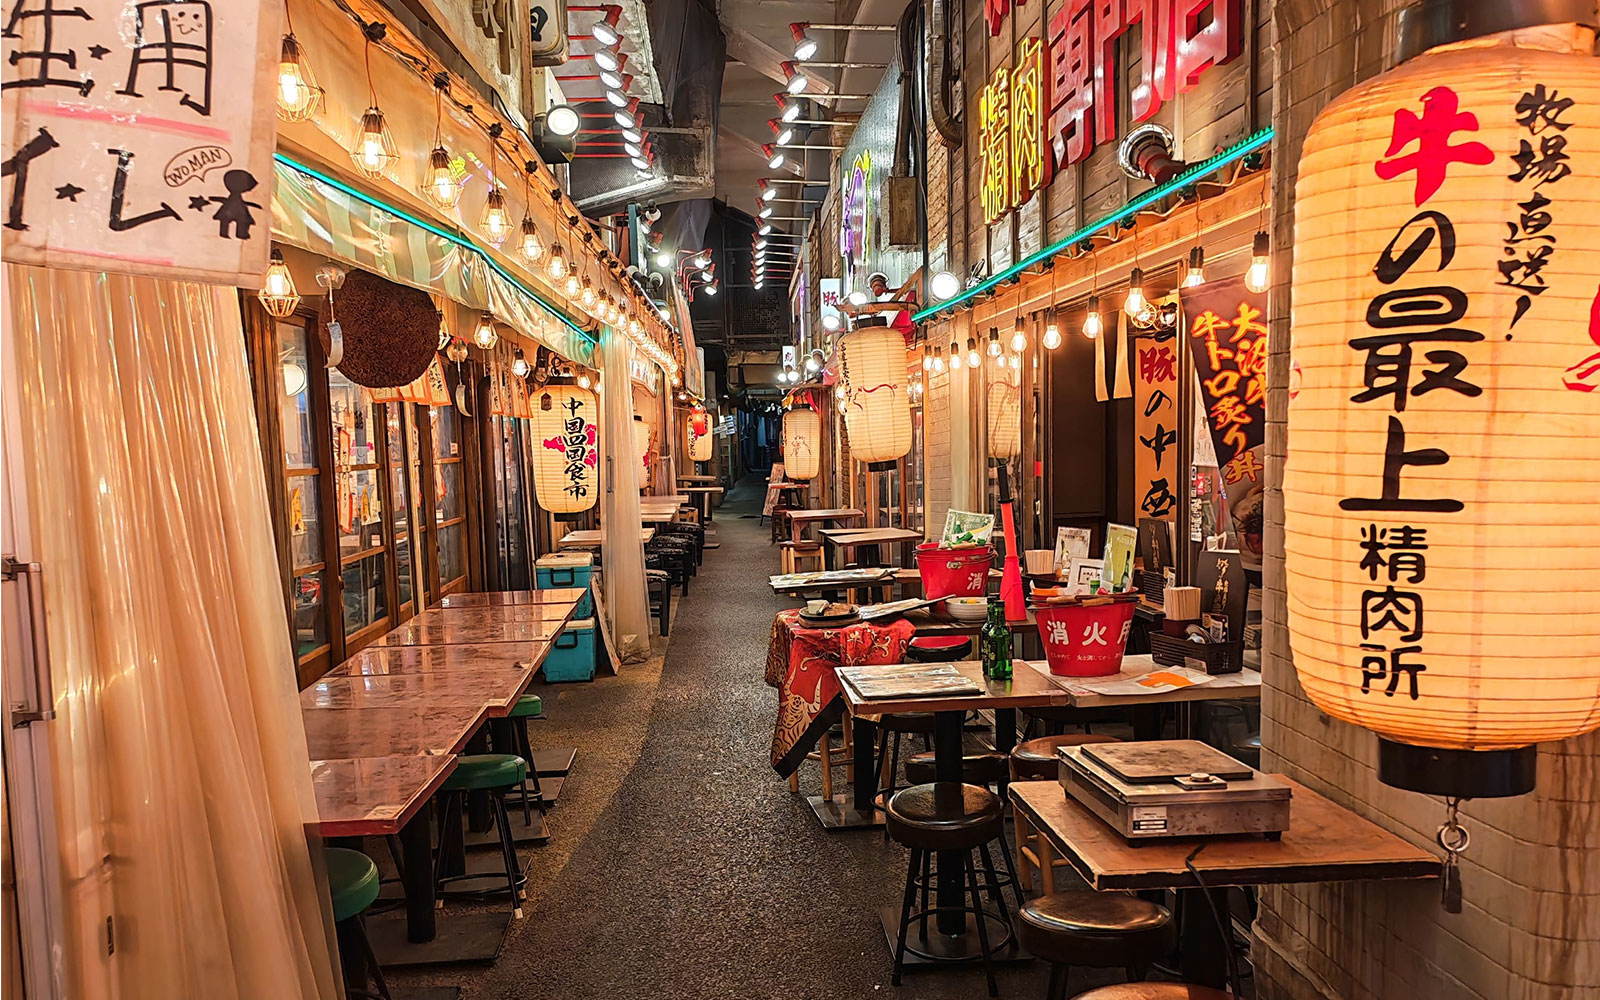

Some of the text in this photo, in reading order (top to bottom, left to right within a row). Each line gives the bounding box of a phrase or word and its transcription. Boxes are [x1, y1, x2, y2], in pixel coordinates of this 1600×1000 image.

[1493, 83, 1576, 341] 牧場直送!
[1139, 346, 1177, 518] 豚の中西
[966, 572, 984, 591] 消
